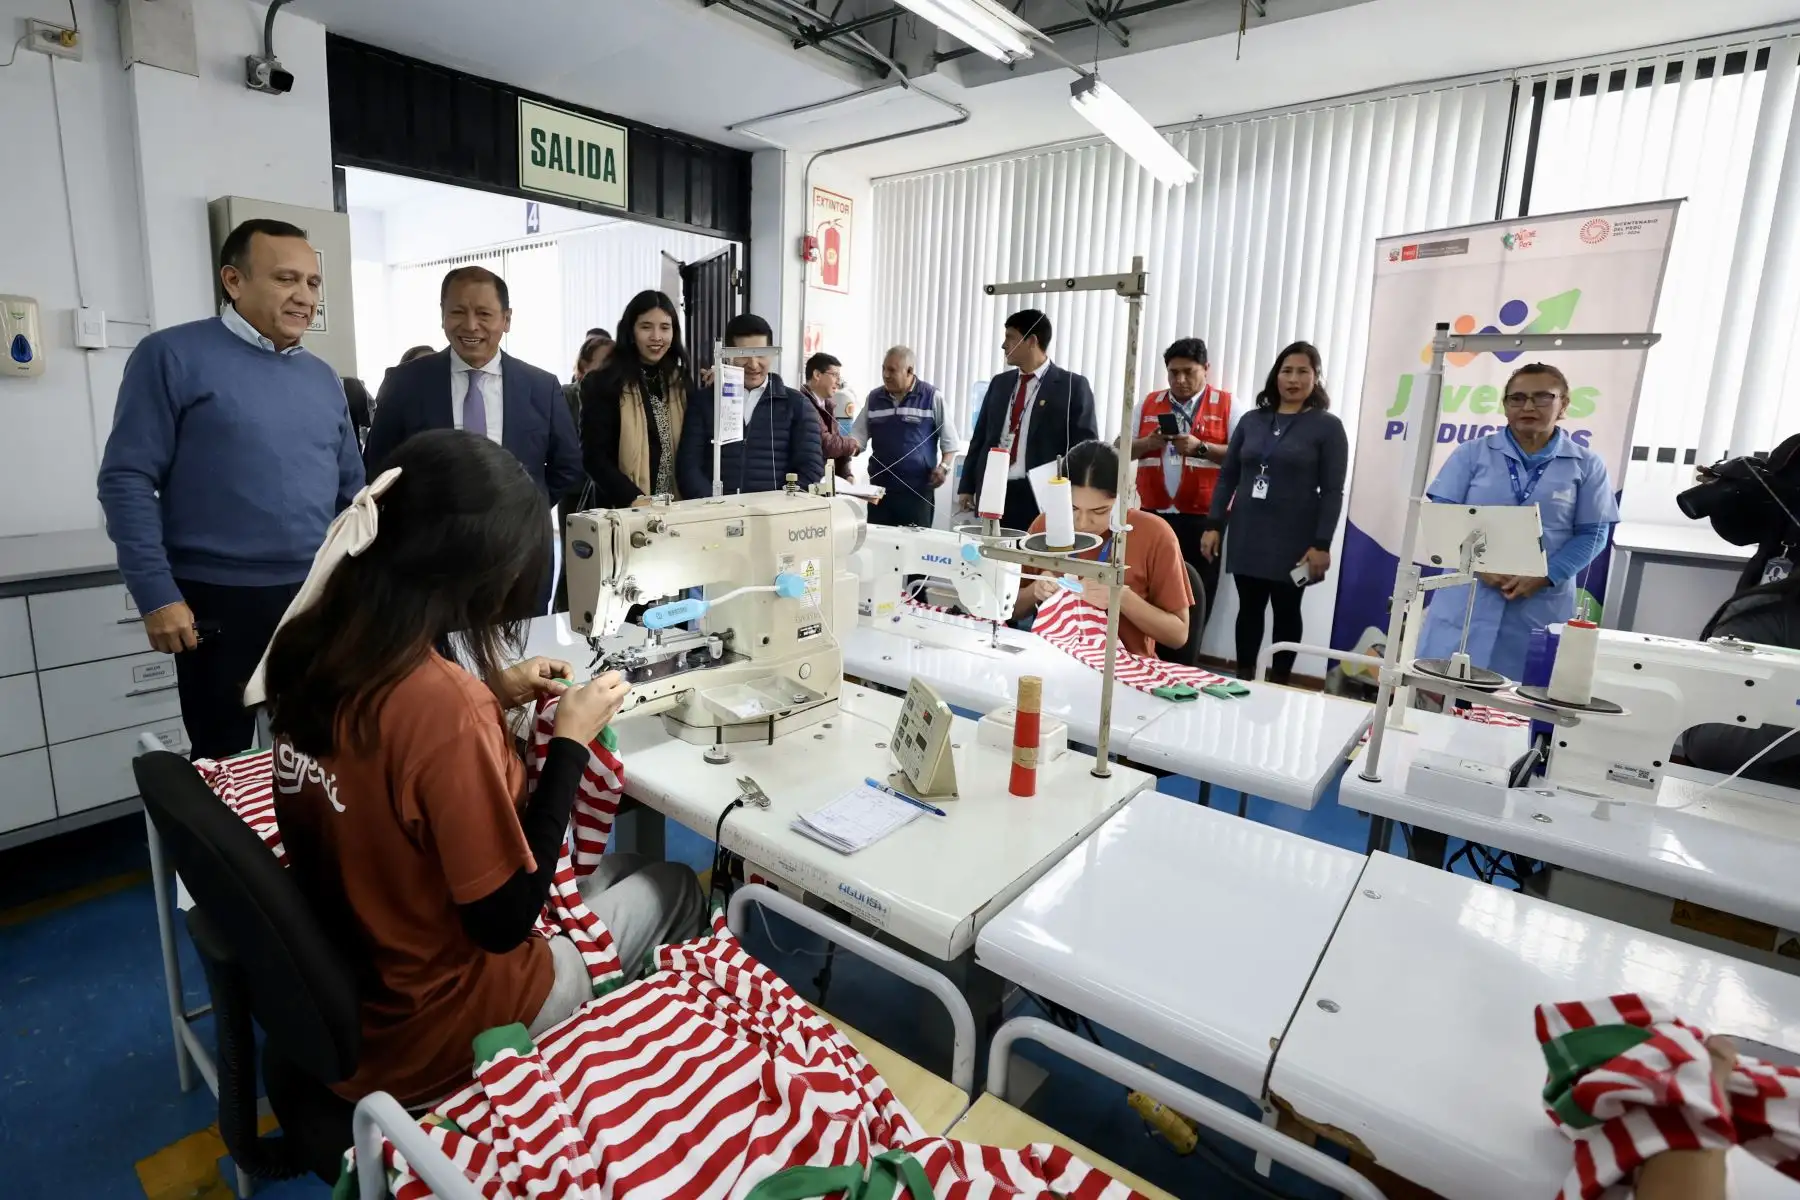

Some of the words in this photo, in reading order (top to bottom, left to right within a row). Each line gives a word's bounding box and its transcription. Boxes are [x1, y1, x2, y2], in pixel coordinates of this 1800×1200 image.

[530, 127, 617, 184] SALIDA
[527, 203, 539, 231] 4
[816, 195, 849, 215] EXTINTOR
[1386, 374, 1601, 418] Jves
[788, 526, 827, 541] brother
